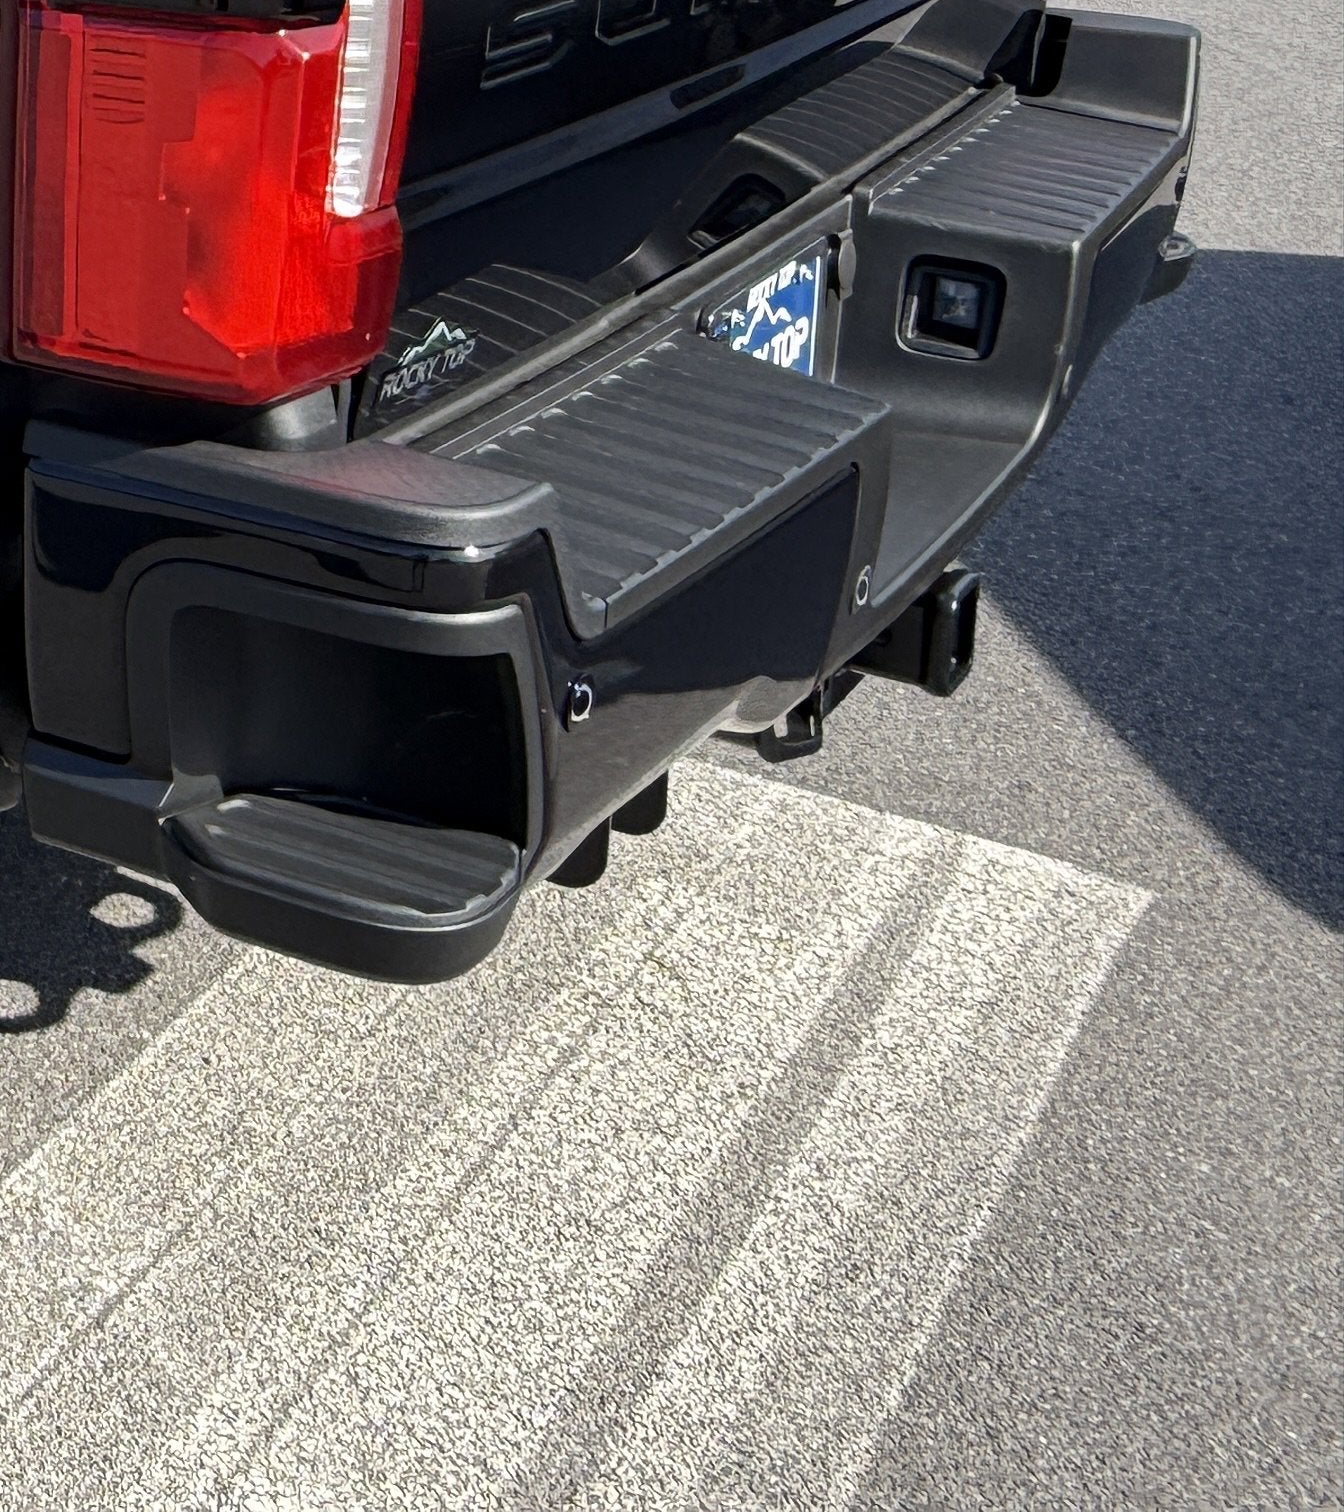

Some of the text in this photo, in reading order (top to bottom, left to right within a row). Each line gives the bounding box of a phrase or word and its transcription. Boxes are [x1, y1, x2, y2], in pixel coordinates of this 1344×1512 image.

[379, 338, 477, 402] ROCKY TOP
[770, 315, 810, 368] TOP
